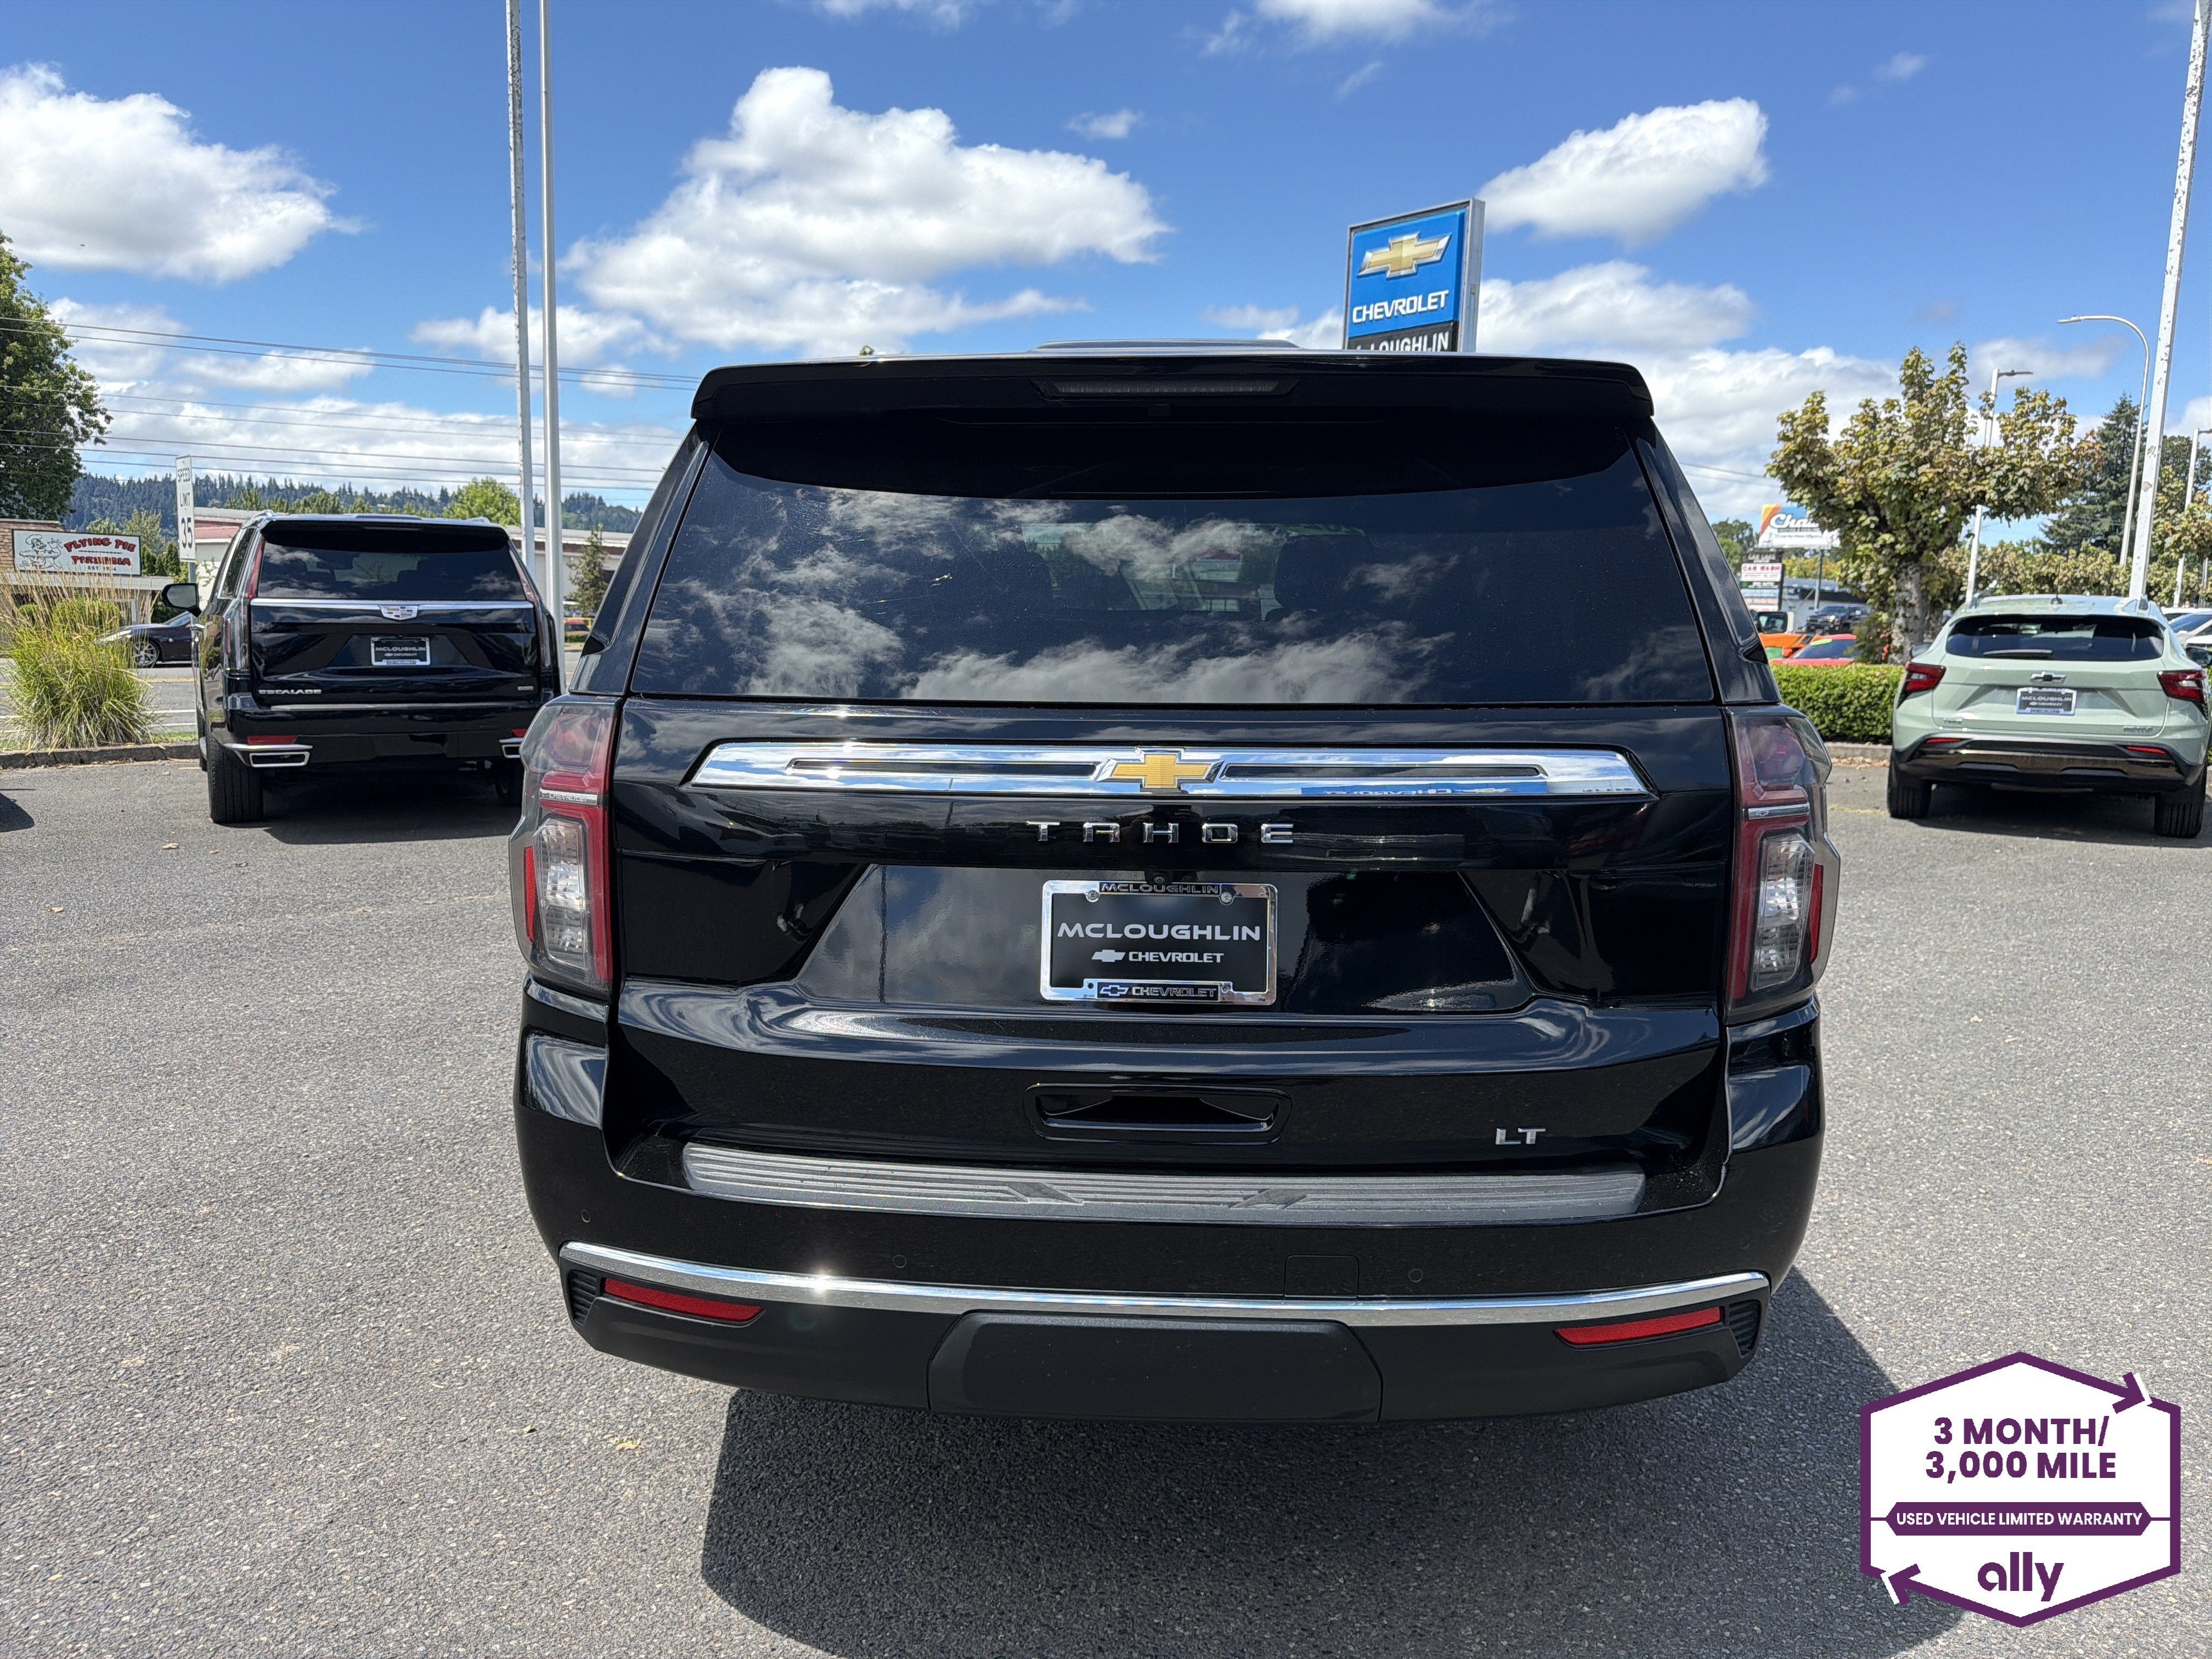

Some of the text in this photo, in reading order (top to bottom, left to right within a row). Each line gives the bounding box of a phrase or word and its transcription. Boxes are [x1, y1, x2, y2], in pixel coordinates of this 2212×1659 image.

[1352, 290, 1449, 323] CHEVROLET
[1357, 331, 1449, 352] OUGHLIN
[177, 467, 190, 483] SPEED
[180, 492, 190, 507] LIMIT
[182, 517, 193, 549] 35
[64, 537, 136, 552] FLYING PIE
[1026, 820, 1294, 844] TAHOE
[1101, 883, 1219, 894] MCLOUGHLIN
[1057, 922, 1261, 941] MCLOUGHLIN
[1128, 951, 1224, 963] CHEVROLET
[1132, 986, 1217, 997] CHEVROLET
[1496, 1127, 1546, 1145] LT
